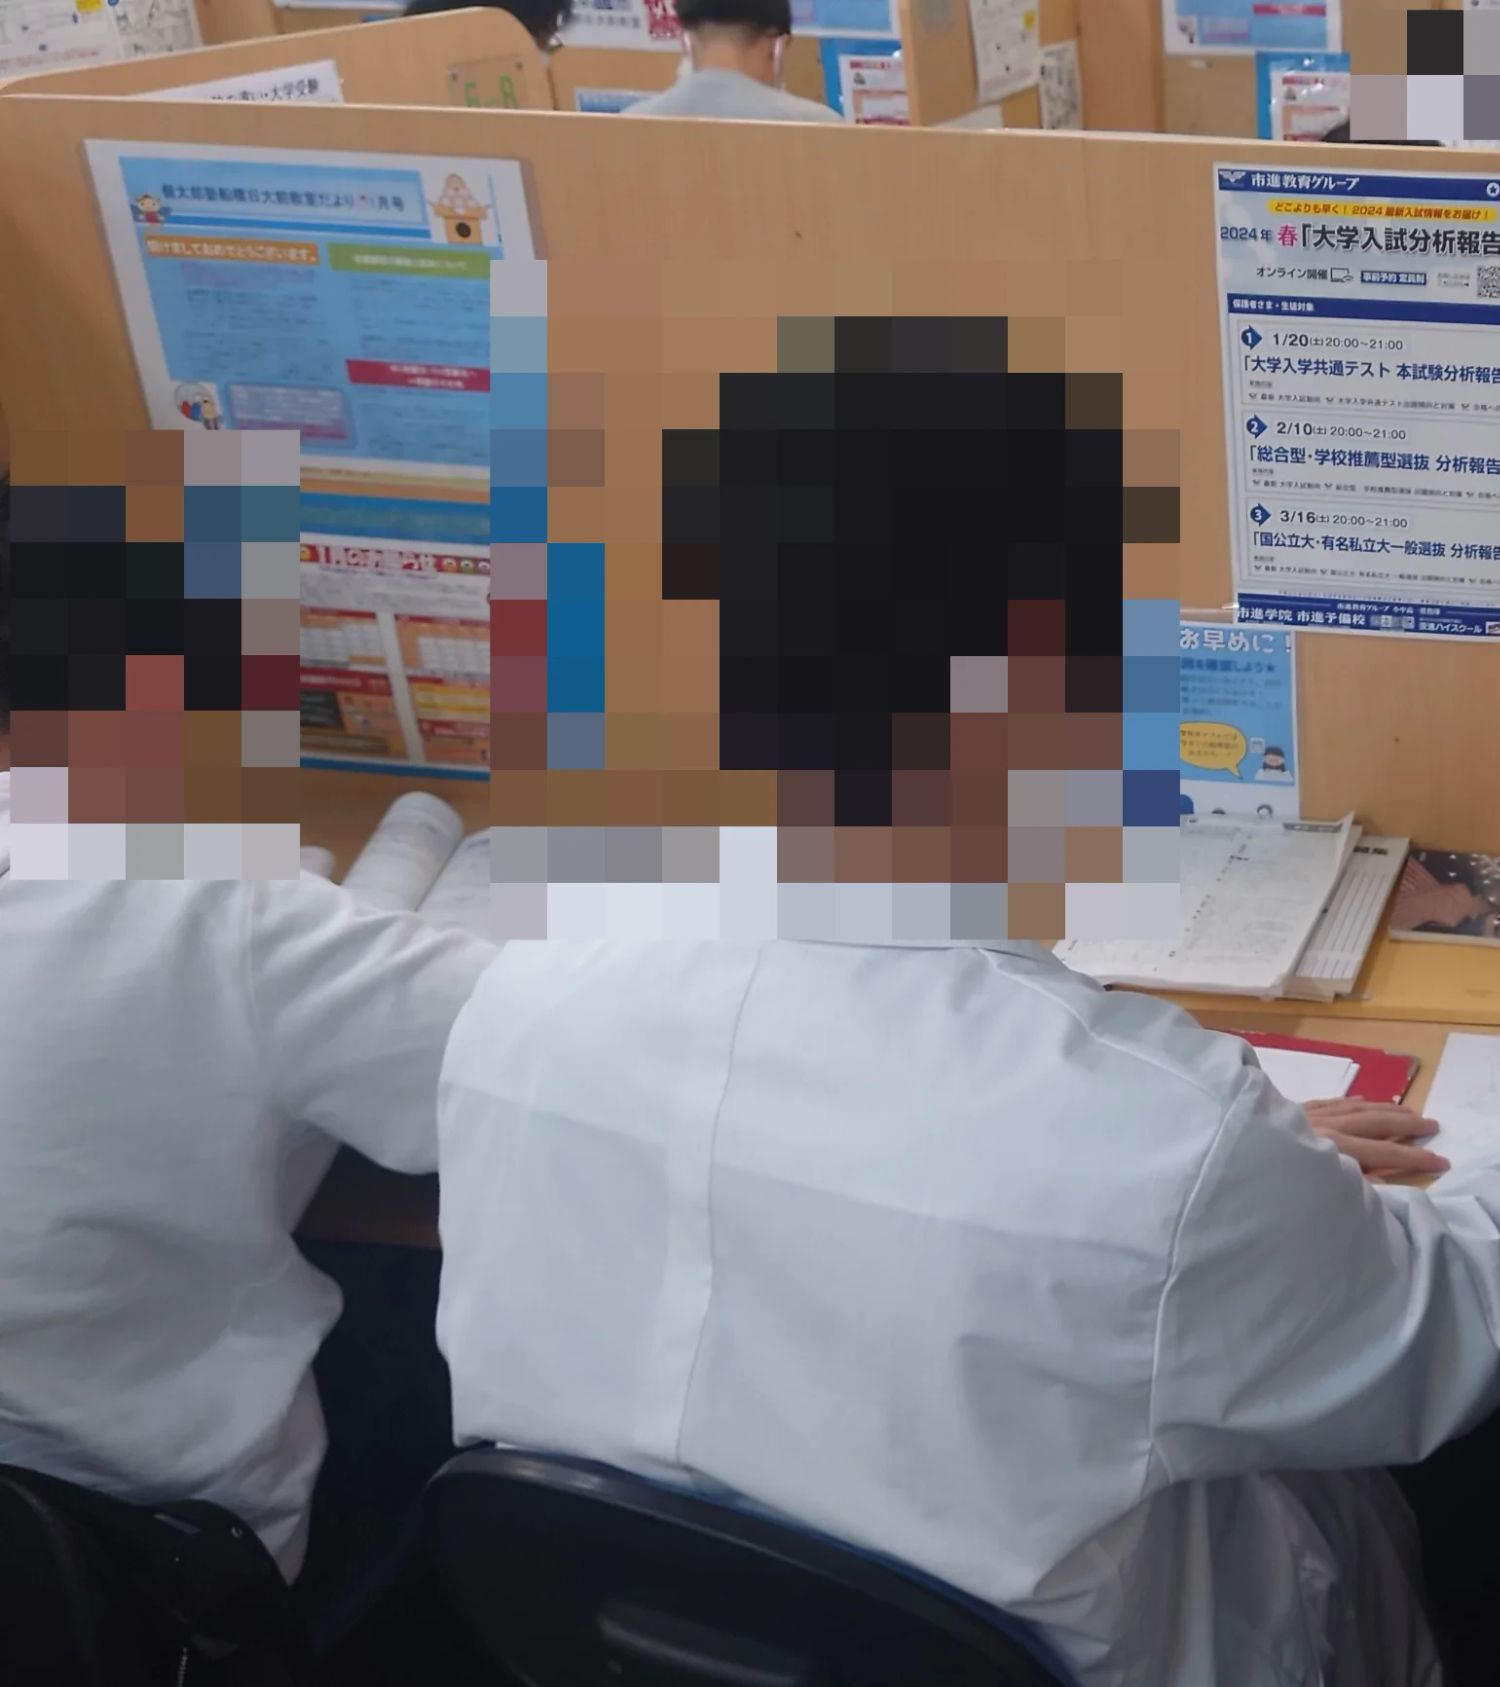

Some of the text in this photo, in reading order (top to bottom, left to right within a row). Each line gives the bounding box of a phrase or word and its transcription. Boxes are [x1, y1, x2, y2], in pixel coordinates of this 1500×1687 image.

[1250, 173, 1360, 191] 市進教育グループ
[1351, 206, 1383, 216] 2024
[1278, 224, 1298, 247] 春
[1256, 267, 1328, 280] オンライン開催
[1244, 355, 1391, 378] 「大学入学共通テスト
[1238, 606, 1293, 622] 市進学院
[1296, 610, 1366, 625] 市進予備校
